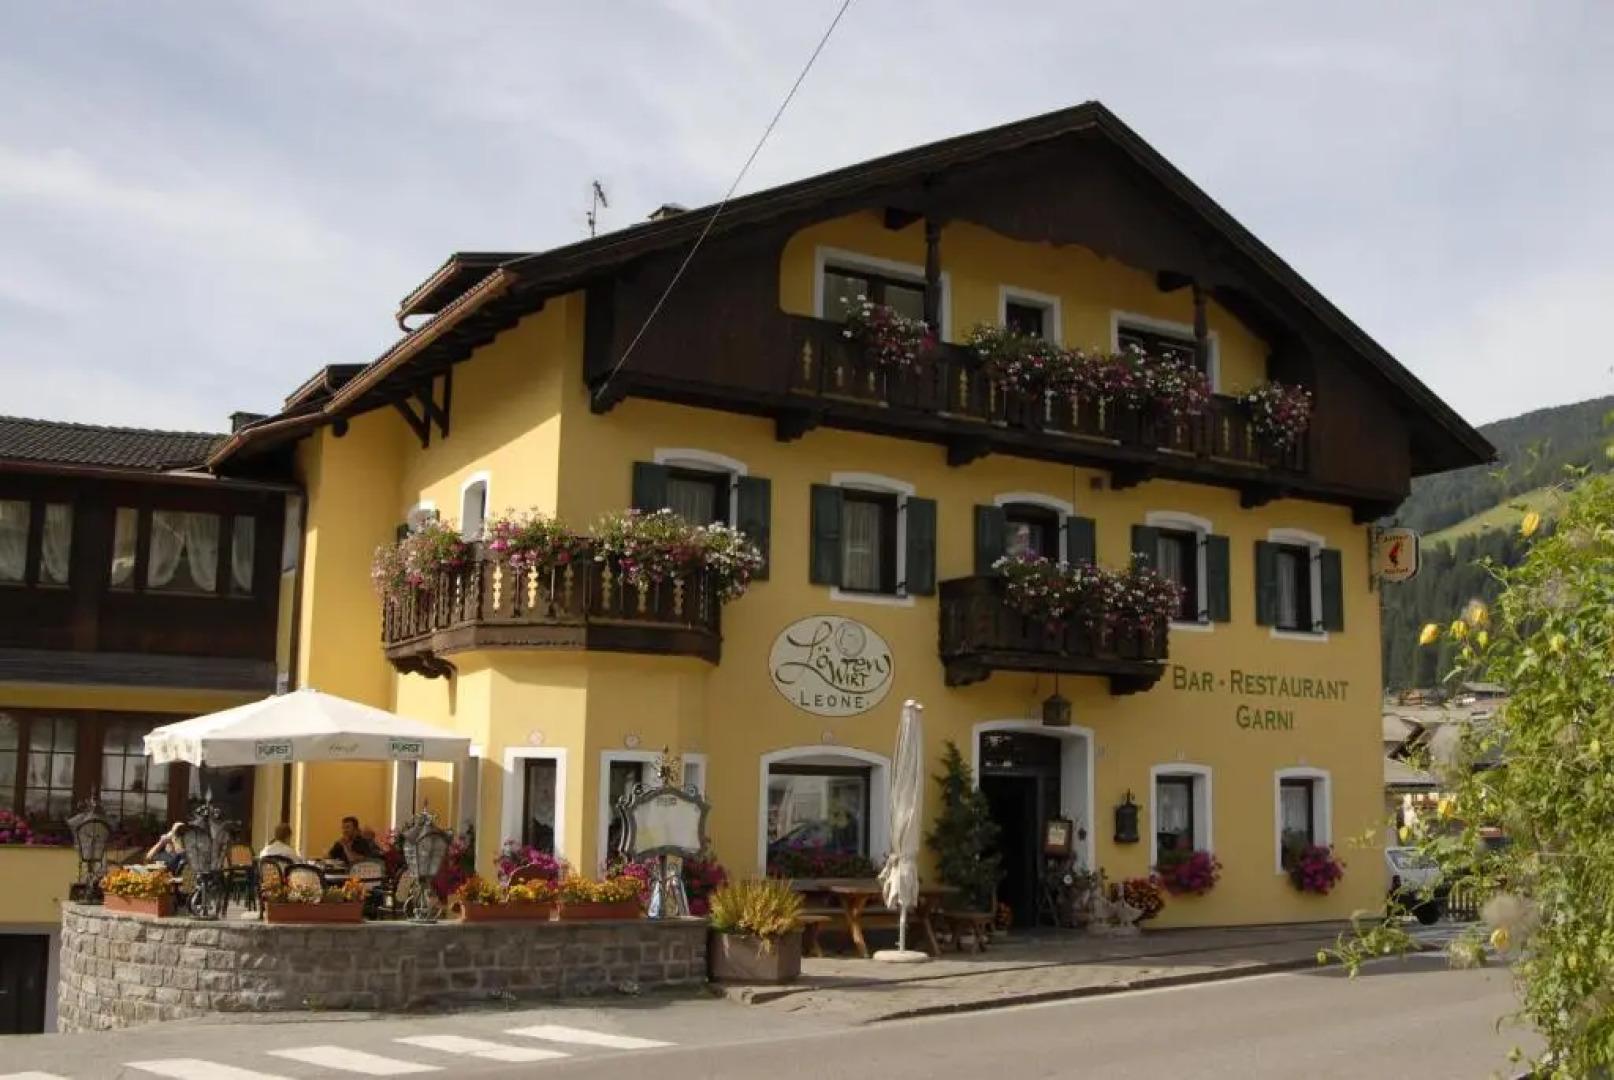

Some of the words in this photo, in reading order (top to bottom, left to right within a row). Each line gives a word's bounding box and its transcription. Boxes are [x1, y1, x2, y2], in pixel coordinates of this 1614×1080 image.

[1173, 666, 1213, 692] BAR
[1230, 669, 1349, 701] RESTAURANT
[800, 690, 864, 709] LEONE
[1236, 704, 1295, 731] GARNI
